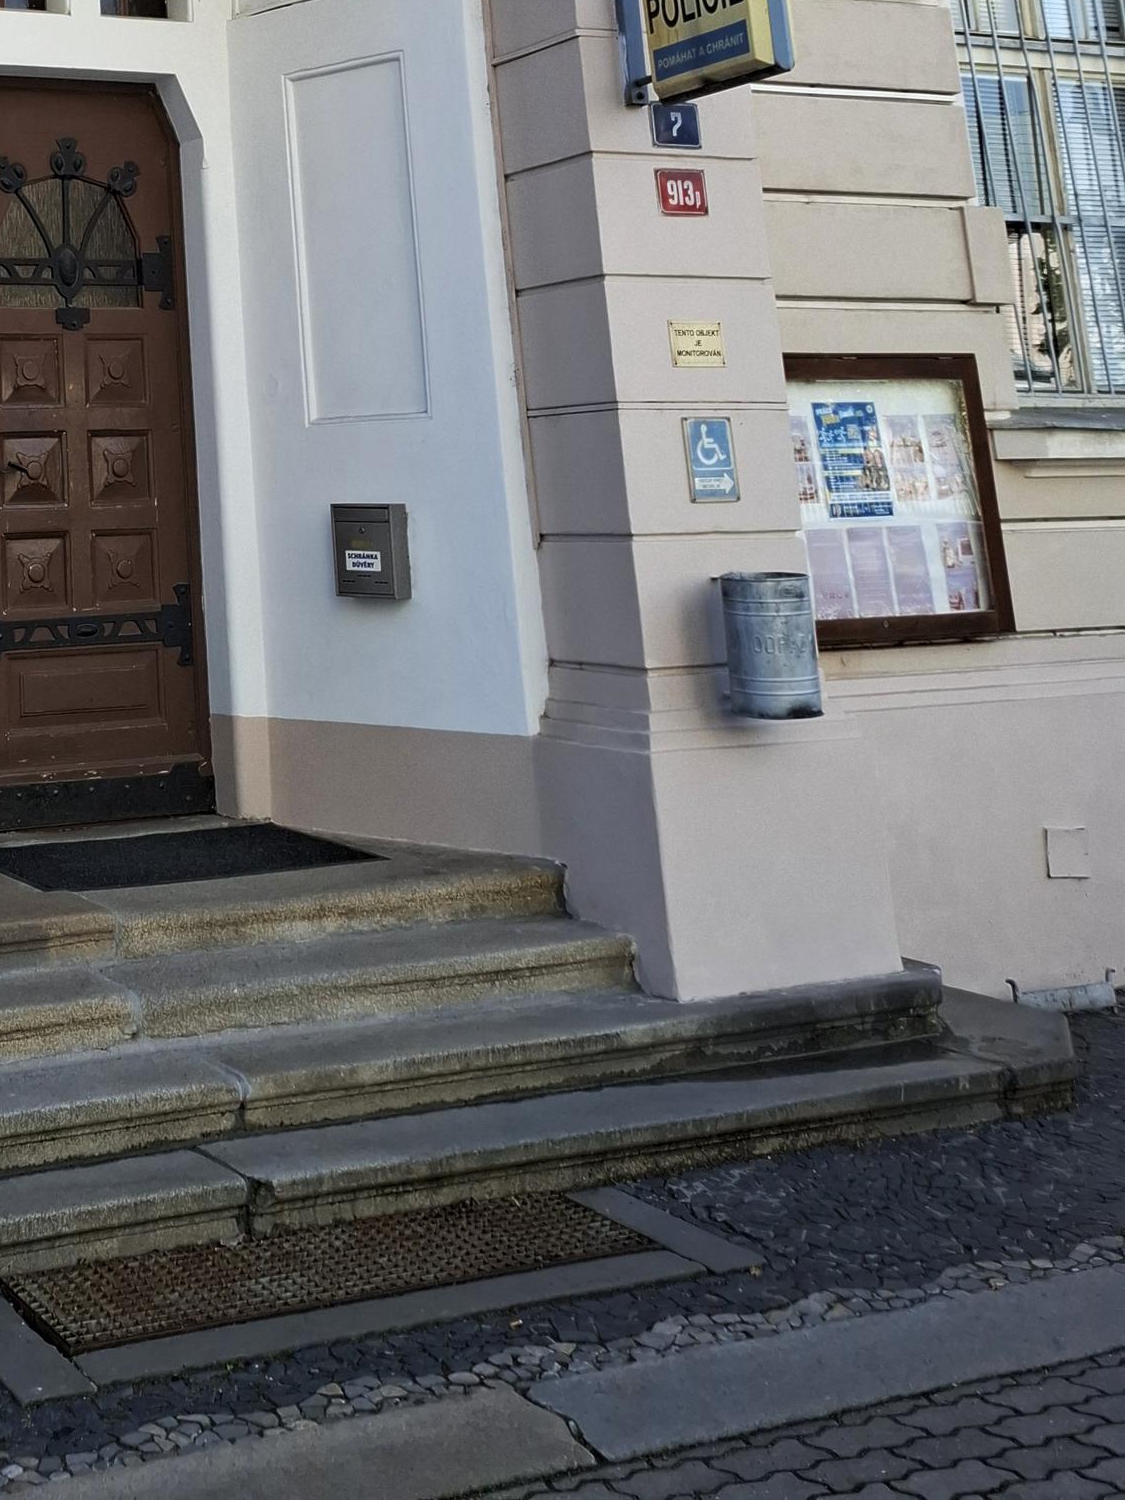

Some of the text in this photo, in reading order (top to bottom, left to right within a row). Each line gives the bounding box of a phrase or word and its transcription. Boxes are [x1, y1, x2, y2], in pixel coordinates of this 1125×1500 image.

[699, 46, 705, 57] A
[670, 112, 682, 137] 7
[674, 329, 719, 337] TENTO OBJEKT
[694, 339, 703, 347] JE
[352, 560, 374, 568] DŮVĚRY
